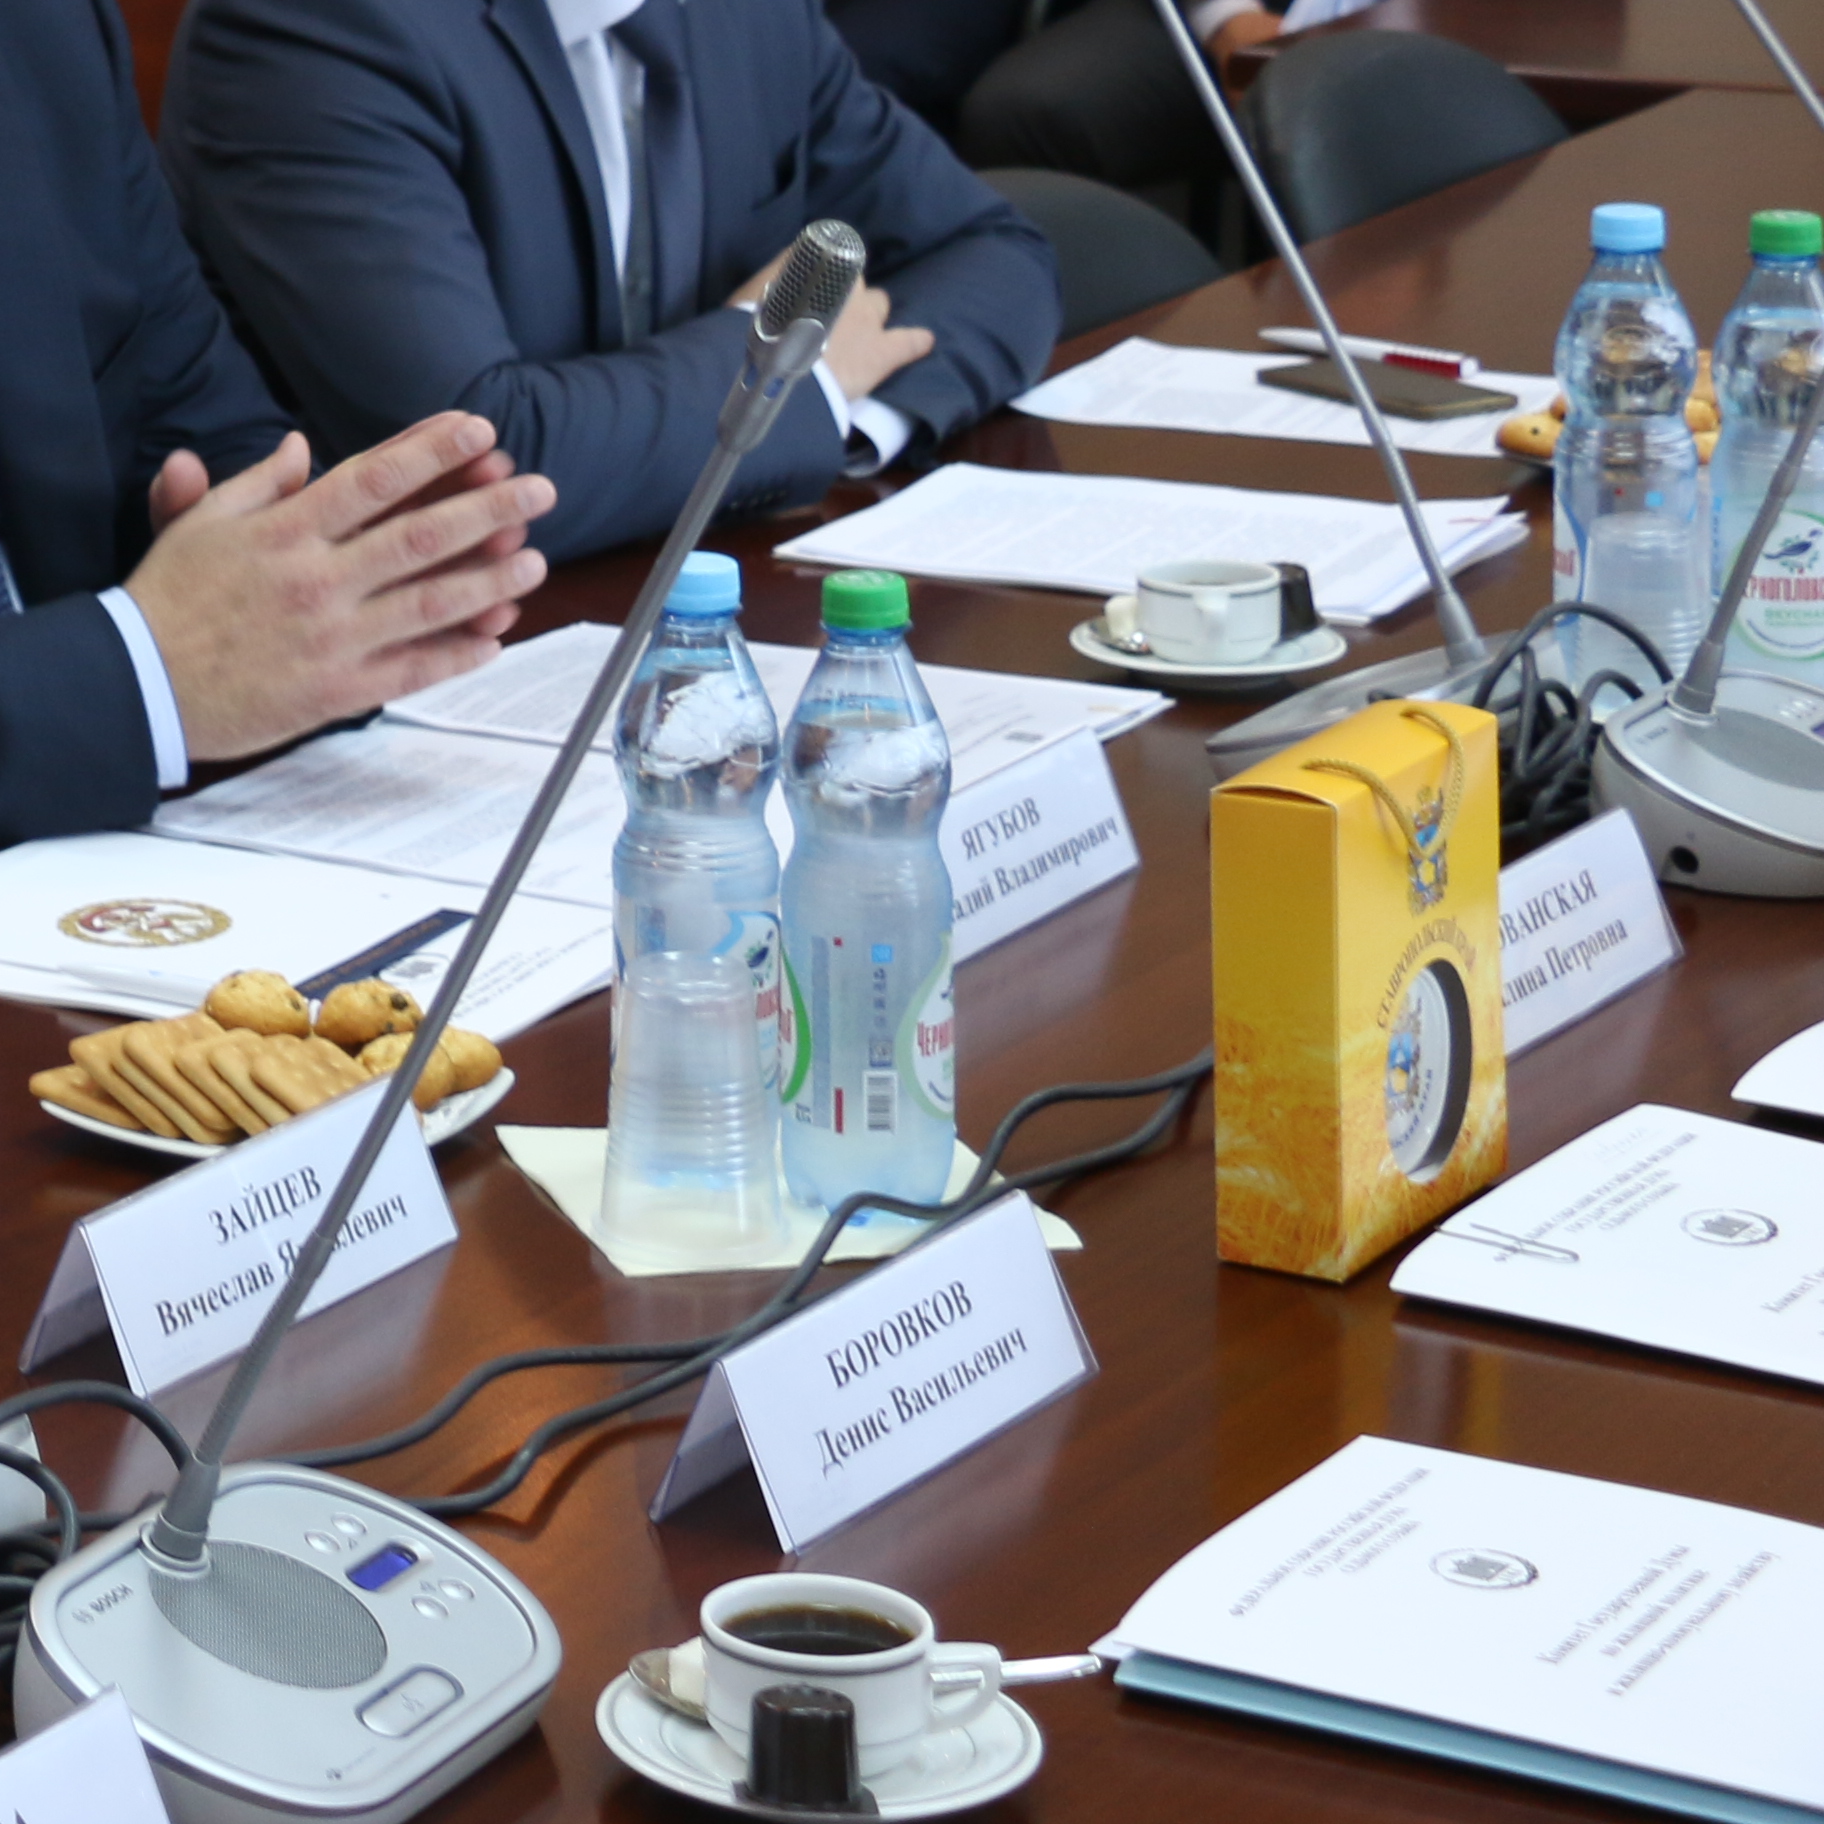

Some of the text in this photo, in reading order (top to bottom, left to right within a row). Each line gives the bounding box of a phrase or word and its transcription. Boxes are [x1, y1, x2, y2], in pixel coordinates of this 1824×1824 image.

[952, 816, 1119, 923] адий Владимирович
[961, 796, 1042, 862] ЯГУБОВ
[1502, 918, 1629, 1008] лина Петровна
[208, 1165, 322, 1246] ЗАЙЦЕВ
[154, 1194, 409, 1337] Вячеслав Ялевич
[824, 1279, 973, 1389] БОРОВКОВ
[813, 1327, 1029, 1482] Денис Васильевич
